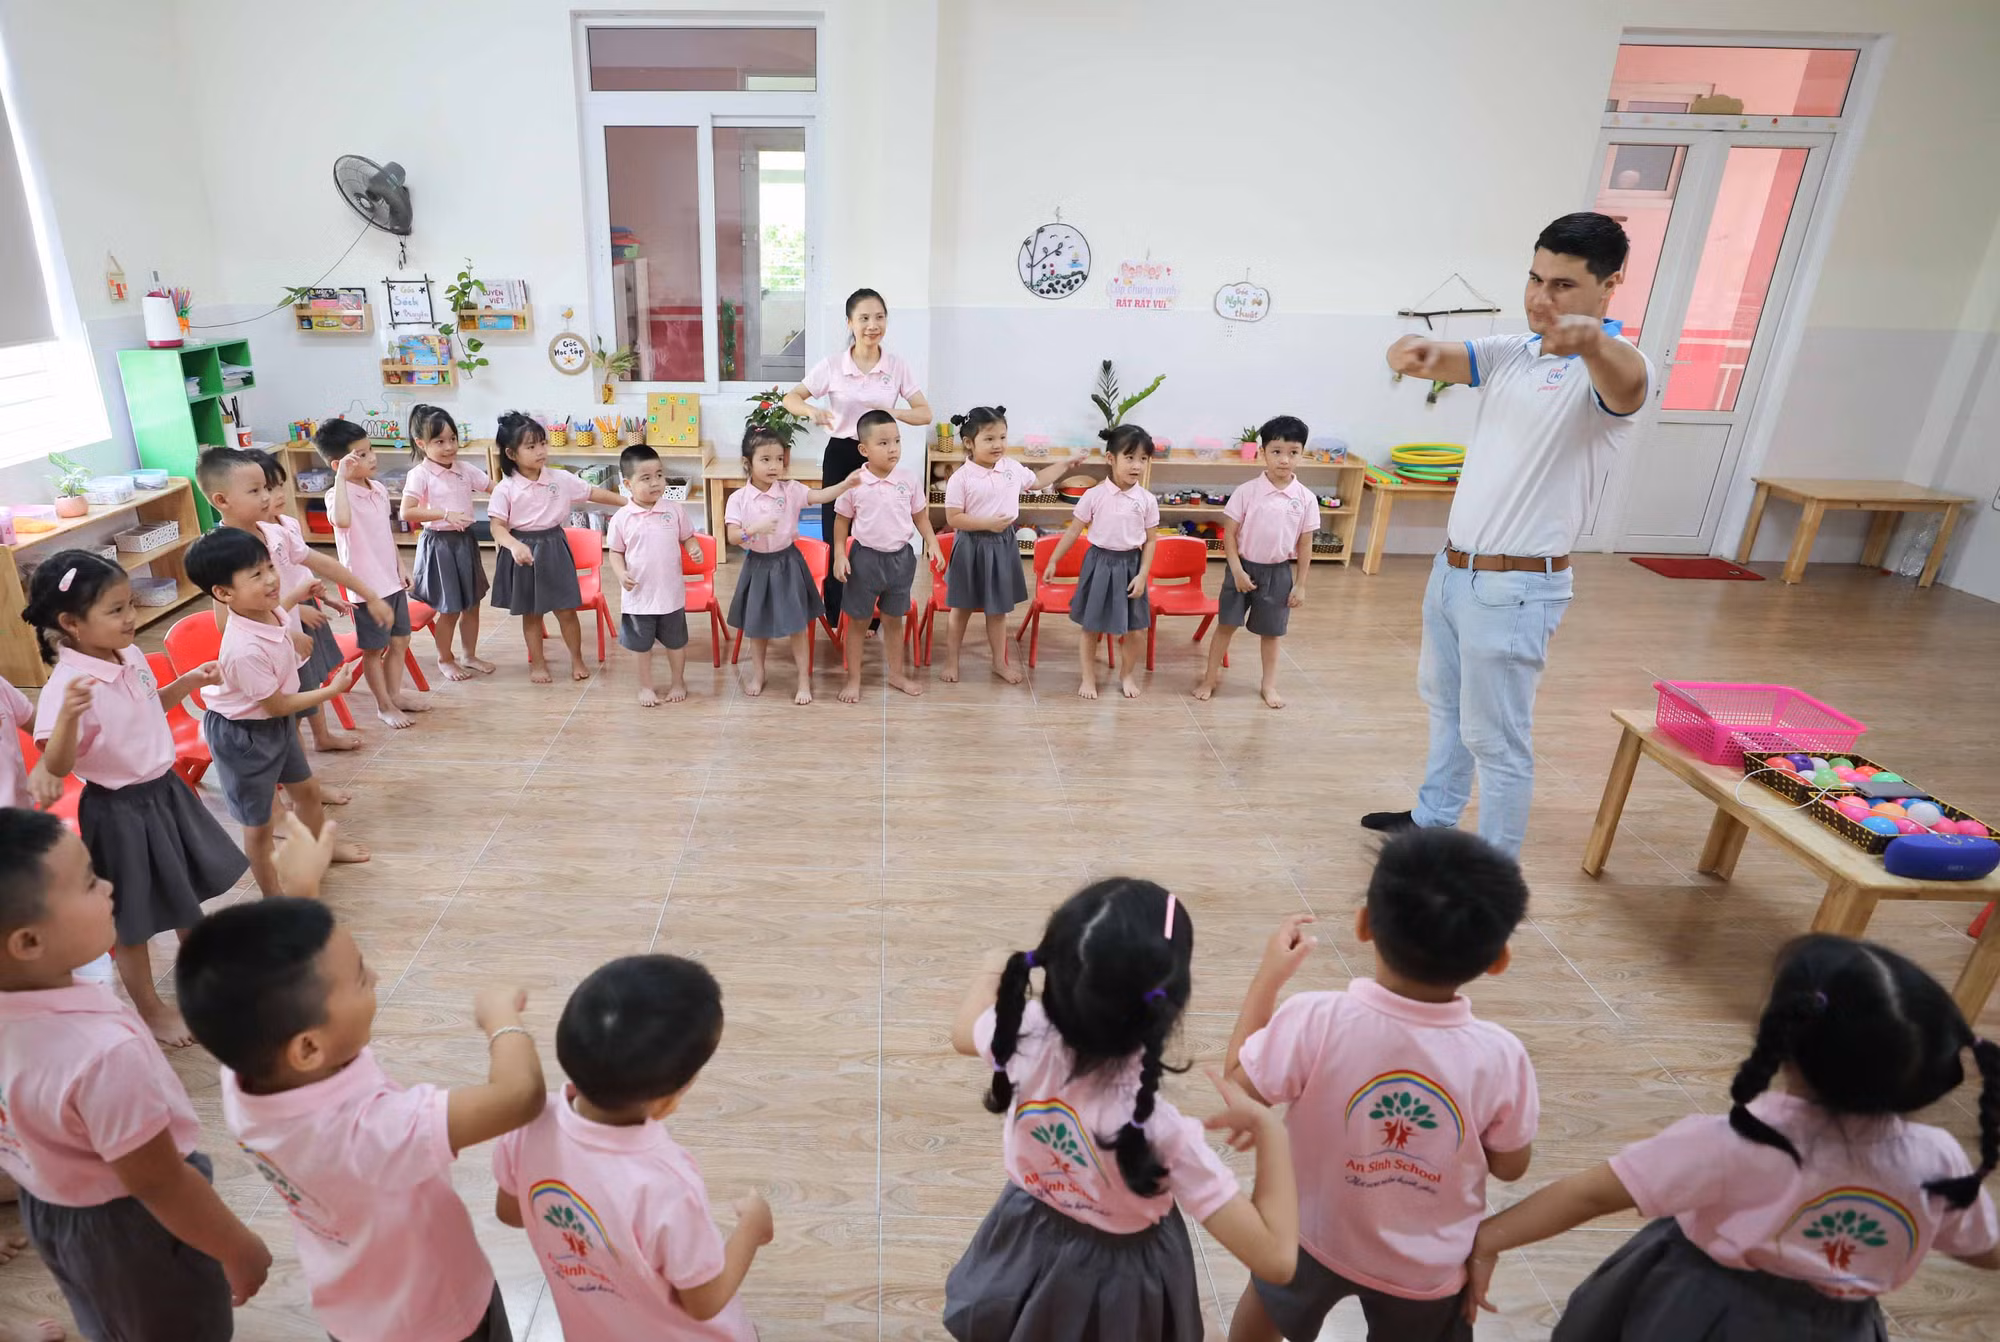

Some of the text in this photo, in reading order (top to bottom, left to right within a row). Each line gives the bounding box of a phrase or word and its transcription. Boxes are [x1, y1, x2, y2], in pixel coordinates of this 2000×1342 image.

[1153, 299, 1167, 309] VUI
[1346, 1158, 1442, 1183] An Sinh School
